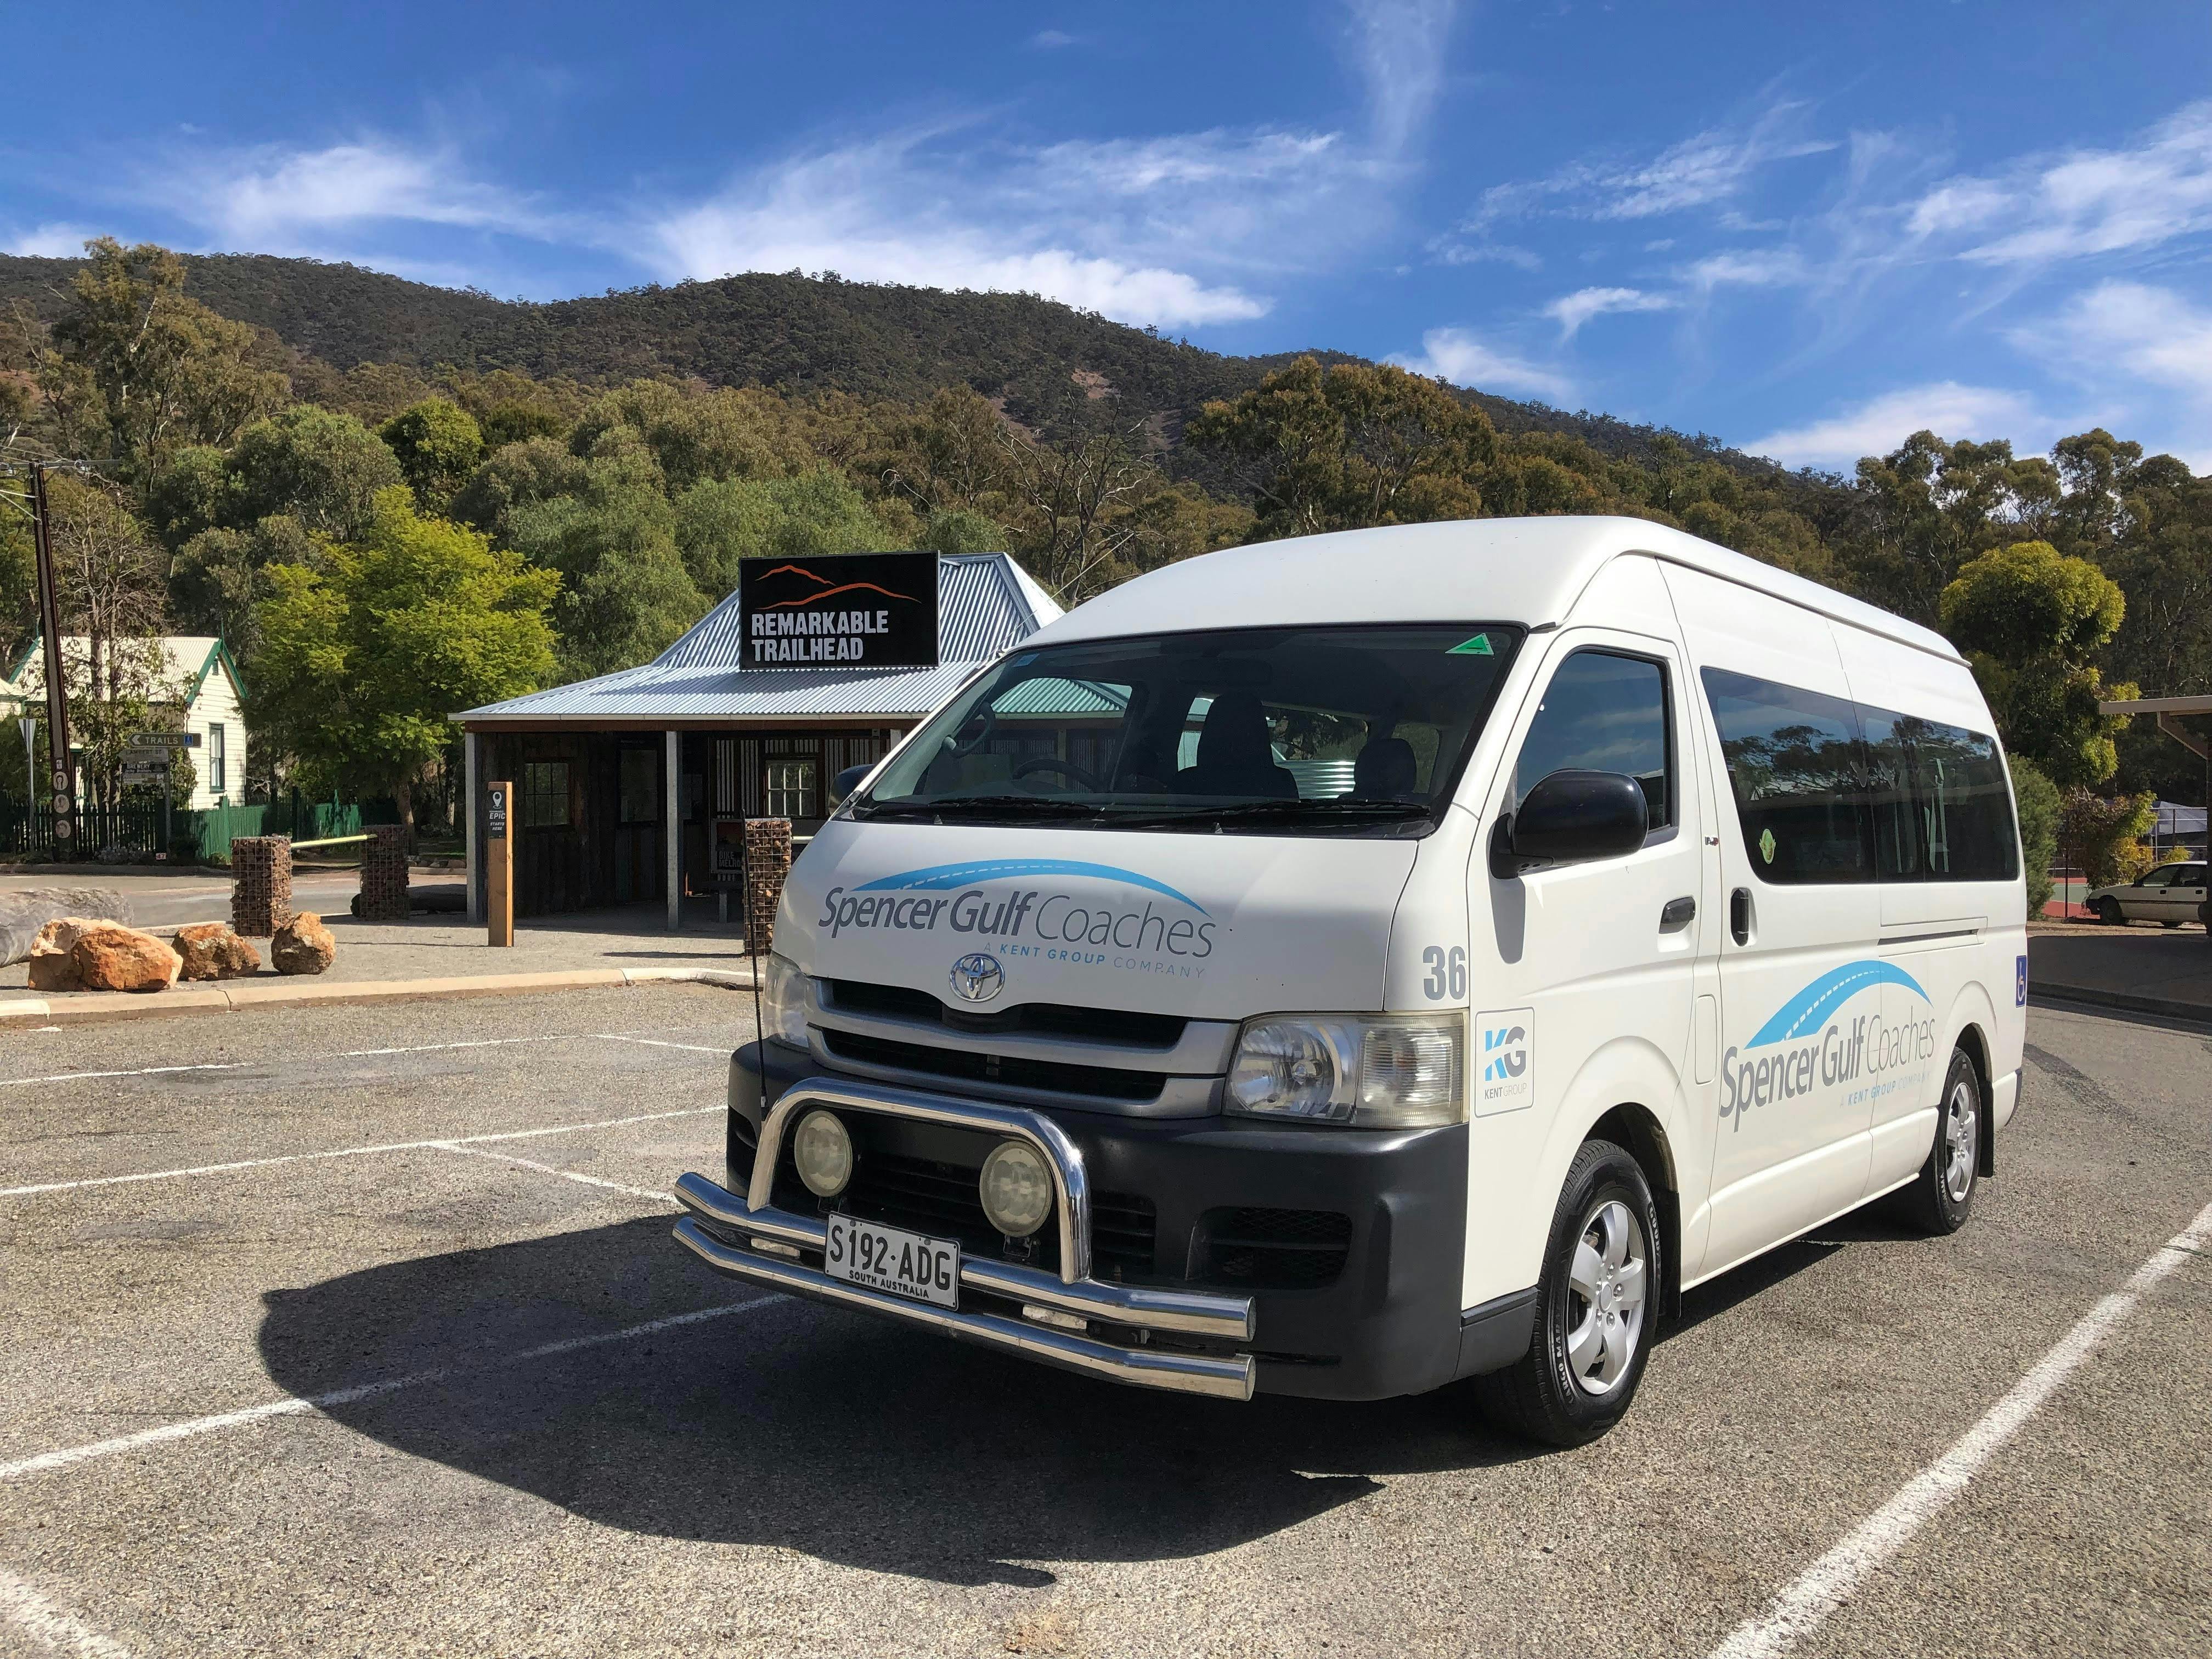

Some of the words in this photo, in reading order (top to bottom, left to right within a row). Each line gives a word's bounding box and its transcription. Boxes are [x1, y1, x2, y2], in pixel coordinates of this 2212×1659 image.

[752, 611, 888, 635] REMARKABLE
[752, 637, 864, 662] TRAILHEAD
[718, 851, 735, 859] BIKE
[718, 859, 741, 867] MELRO
[819, 887, 948, 939] Spencer
[949, 890, 1039, 936] Gulf
[1035, 894, 1217, 958] Coaches
[983, 942, 992, 952] A
[1000, 944, 1041, 958] KENT
[1047, 949, 1106, 965] GROUP
[1113, 956, 1205, 979] COMPANY
[1423, 945, 1466, 1001] 36
[1485, 1026, 1527, 1082] KG
[1719, 1043, 1820, 1133] Spencer
[1821, 1015, 1866, 1087] Gulf
[1865, 1005, 1936, 1074] Coaches
[1848, 1088, 1869, 1106] KENT
[1871, 1080, 1897, 1099] GROUP
[1898, 1071, 1931, 1090] COMPANY
[849, 1269, 877, 1285] SOUTH
[880, 1278, 929, 1299] AUSTRALIA
[1558, 1362, 1574, 1404] CARGO
